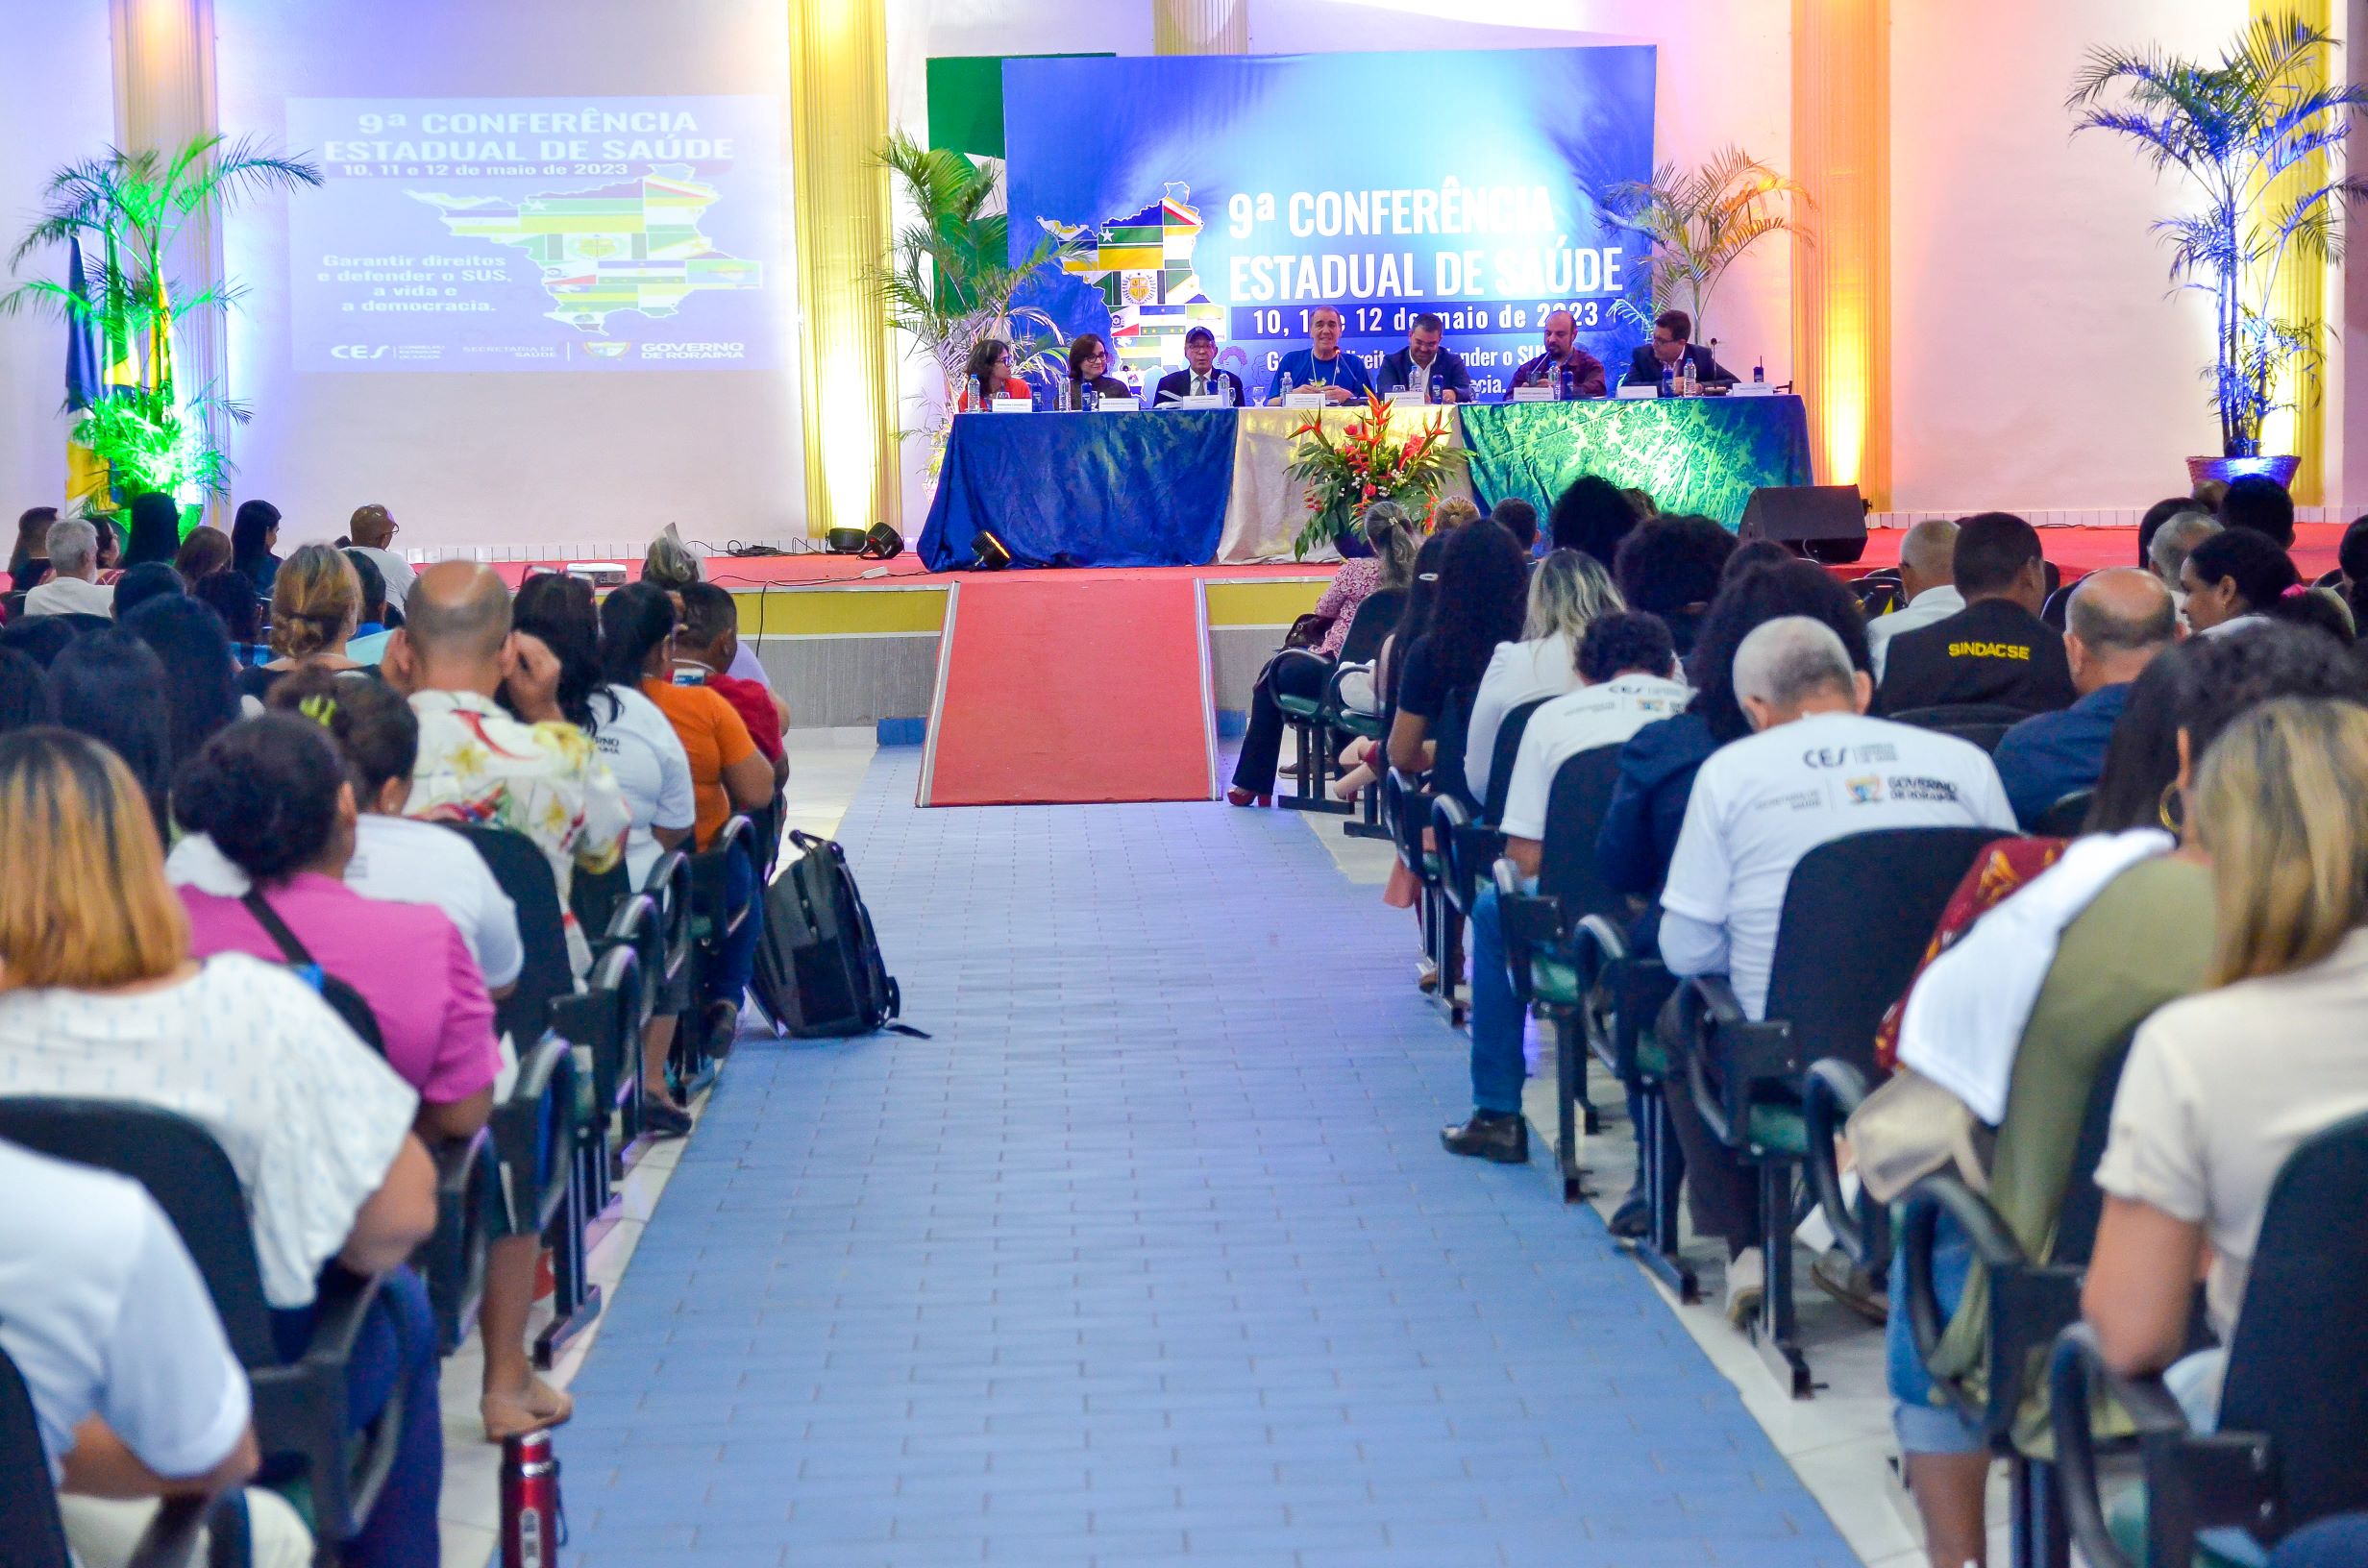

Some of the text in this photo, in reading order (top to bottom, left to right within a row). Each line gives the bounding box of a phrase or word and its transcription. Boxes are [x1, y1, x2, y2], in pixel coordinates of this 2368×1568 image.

[422, 108, 700, 134] CONFERÊNCIA
[324, 135, 736, 162] ESTADUAL DE SAÚDE
[380, 164, 400, 176] 11
[425, 164, 451, 176] 12
[455, 164, 480, 176] de
[485, 164, 536, 175] maio
[542, 164, 568, 175] de
[575, 163, 629, 175] 2023
[1289, 175, 1556, 237] CONFERÊNCIA
[322, 255, 506, 266] Garantir direitos
[1230, 234, 1623, 301] ESTADUAL DE SAÚDE
[337, 269, 435, 282] defender
[392, 285, 438, 296] vida
[361, 300, 497, 311] democracia.
[1253, 308, 1289, 337] 10,
[1356, 307, 1383, 331] 12
[1439, 306, 1489, 330] maio
[1498, 304, 1527, 329] de
[330, 345, 389, 359] CES
[640, 342, 745, 353] GOVERNO
[1502, 351, 1514, 366] o
[1947, 641, 2031, 661] SINDACSE
